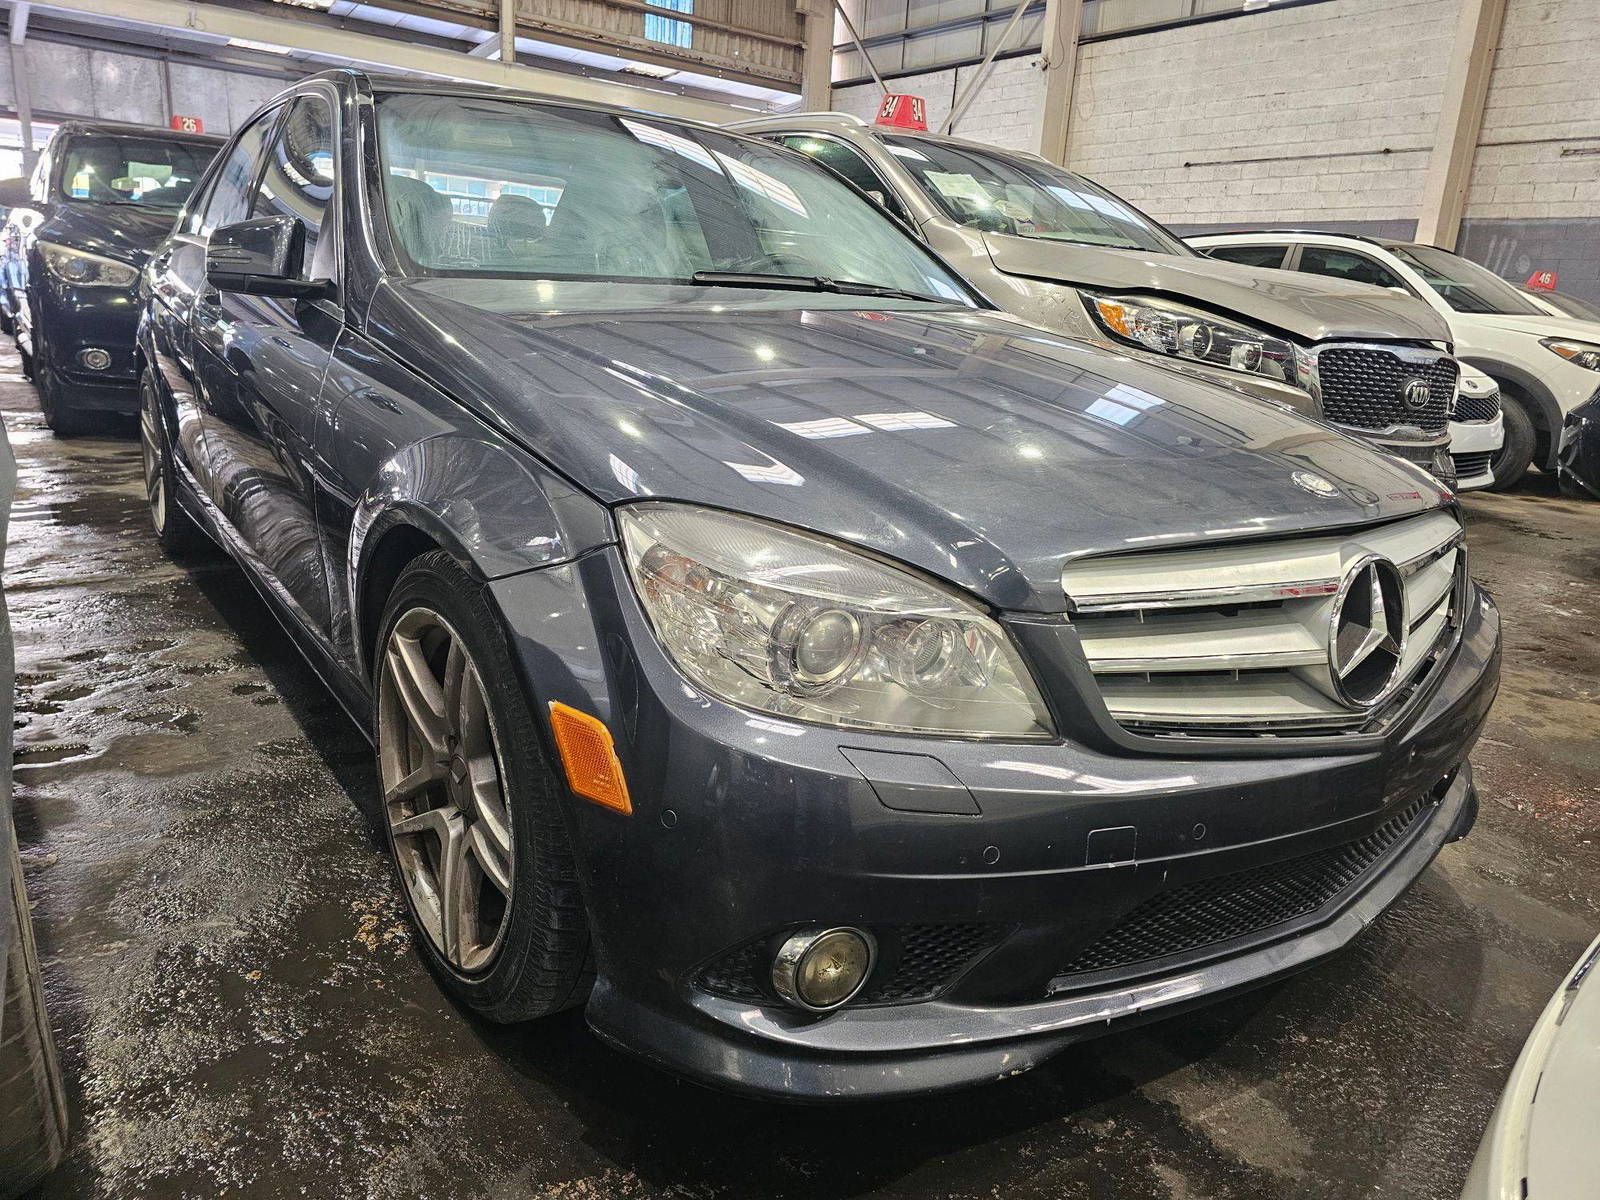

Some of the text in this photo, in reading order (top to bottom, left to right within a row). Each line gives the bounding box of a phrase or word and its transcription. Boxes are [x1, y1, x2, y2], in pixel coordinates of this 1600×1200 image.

[881, 95, 899, 118] 34
[912, 98, 923, 123] 34
[182, 117, 197, 132] 26
[1539, 272, 1552, 284] 46
